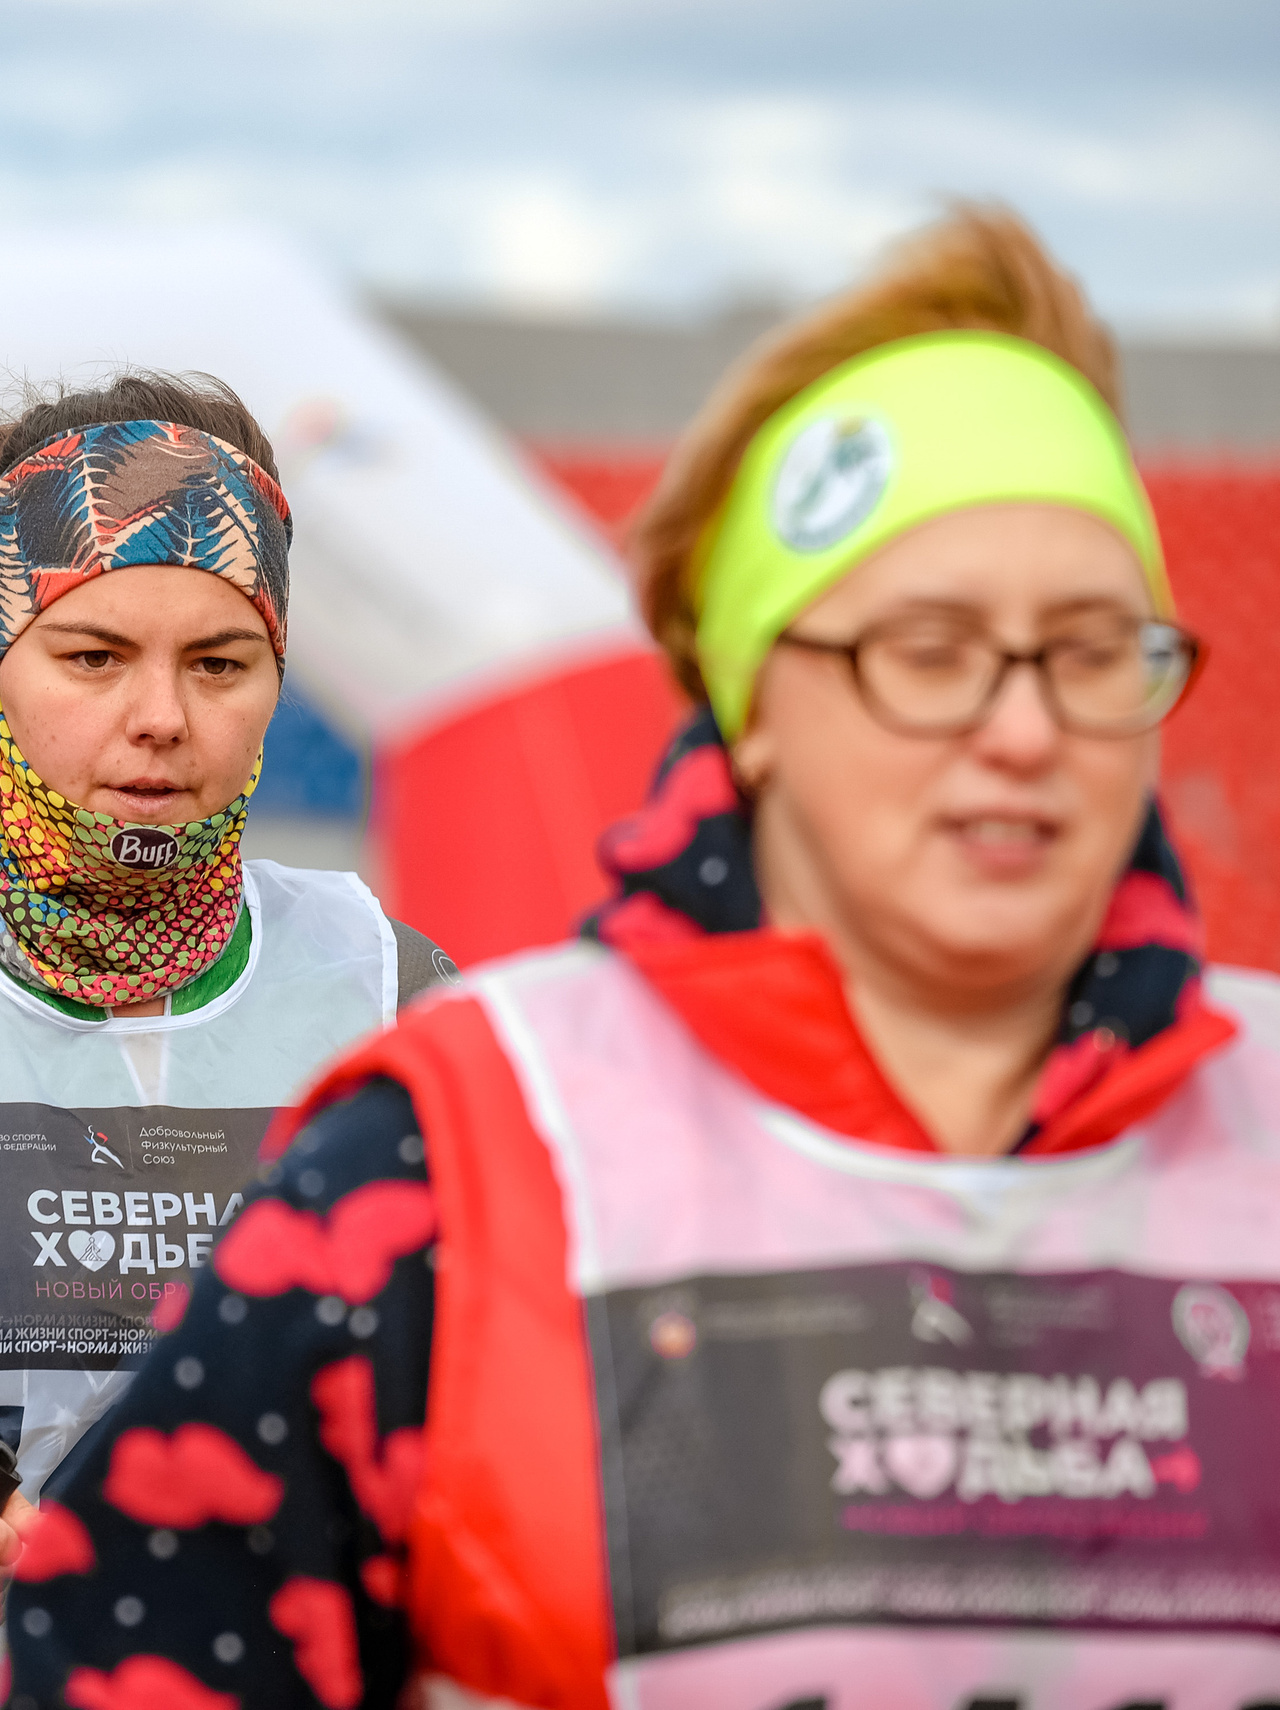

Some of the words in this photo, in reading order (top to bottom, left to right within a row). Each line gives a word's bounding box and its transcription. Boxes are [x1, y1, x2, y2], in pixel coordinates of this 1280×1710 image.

[118, 834, 175, 868] Buff
[12, 1133, 47, 1142] СПОРТА
[139, 1125, 225, 1140] Добровольный
[3, 1142, 57, 1152] ФЕДЕРАЦИИ
[141, 1140, 228, 1155] Физкультурный
[142, 1153, 176, 1165] Союз
[35, 1278, 122, 1300] НОВЫЙ
[14, 1314, 65, 1327] НОРМА
[67, 1315, 117, 1328] ЖИЗНИ
[15, 1327, 65, 1340] ЖИЗНИ
[67, 1328, 109, 1341] СПОРТ
[15, 1340, 57, 1353] СПОРТ
[67, 1341, 117, 1355] НОРМА
